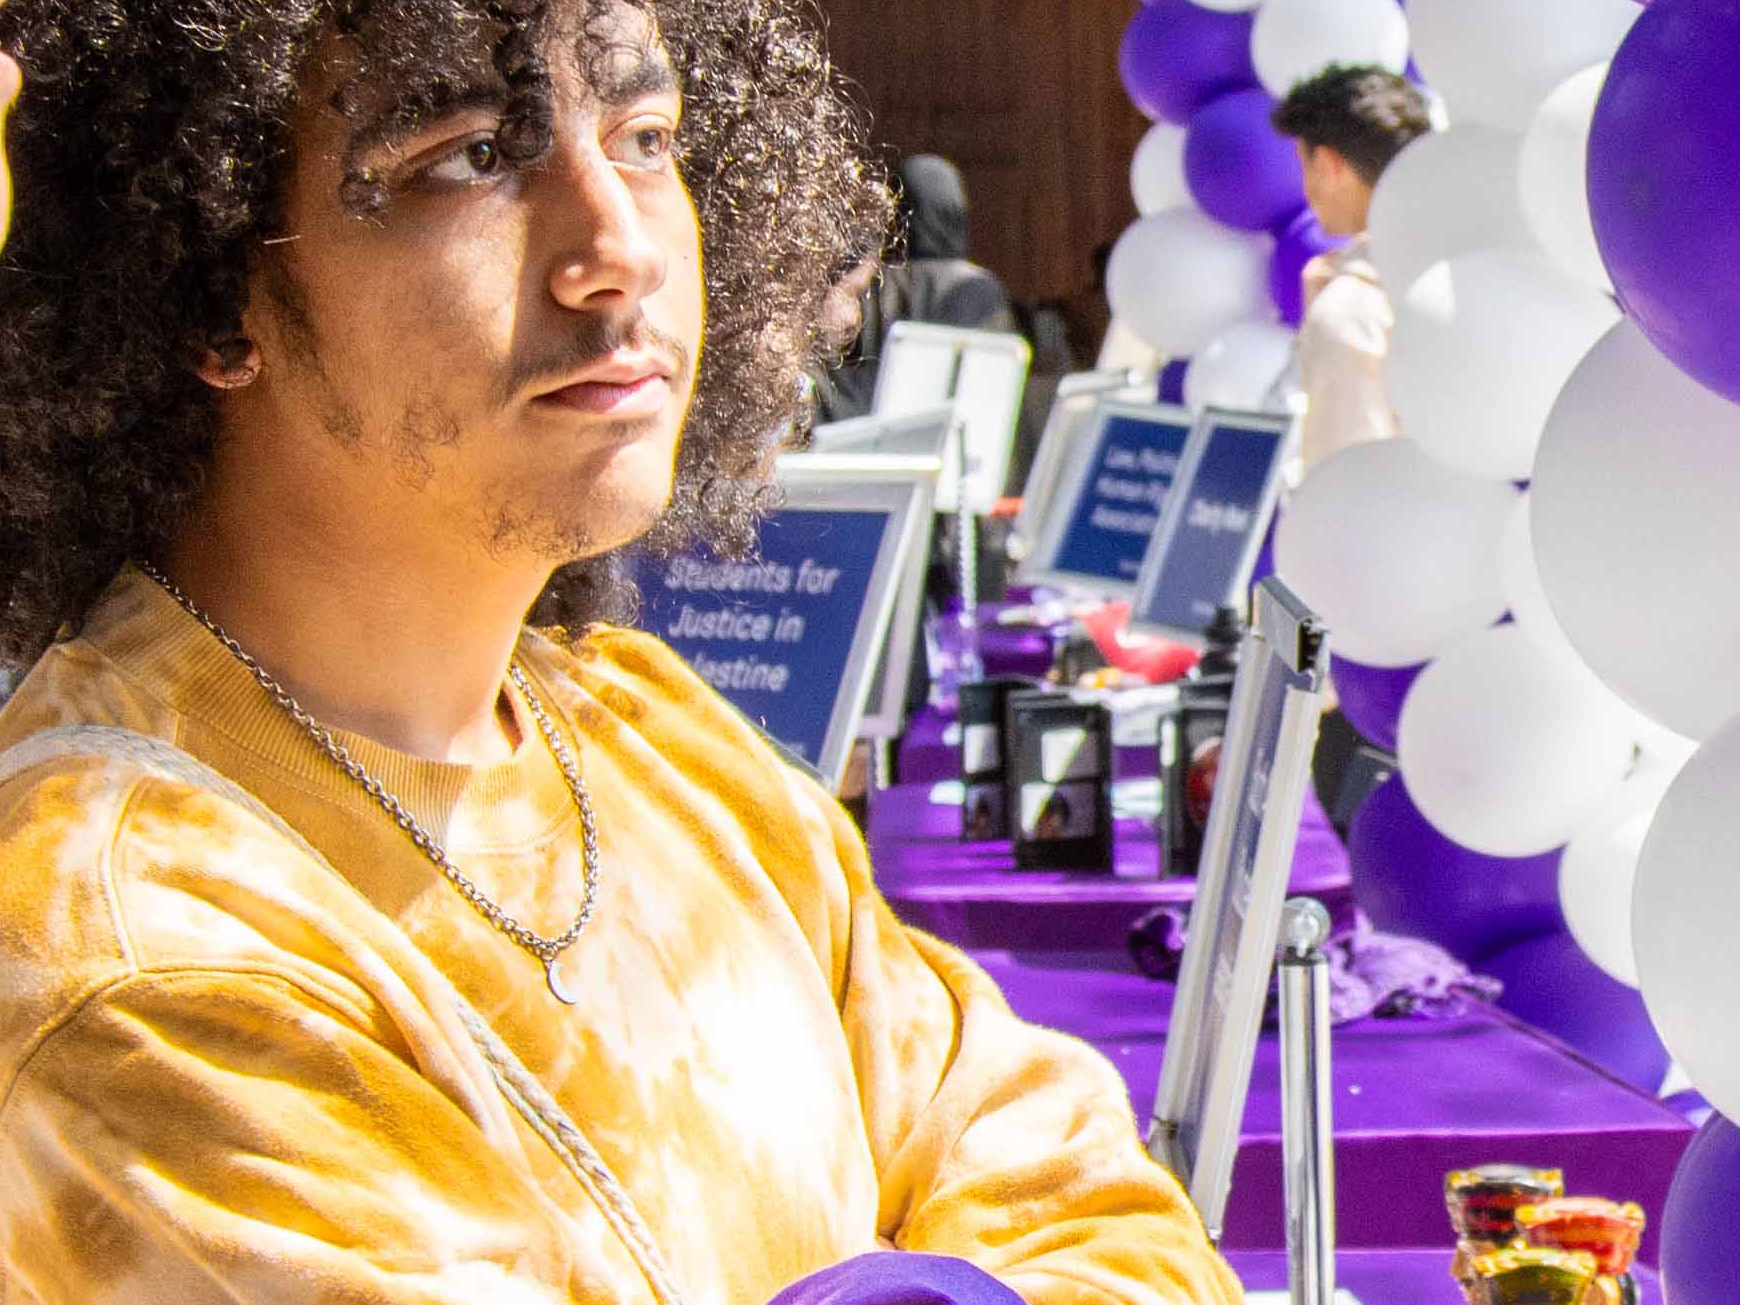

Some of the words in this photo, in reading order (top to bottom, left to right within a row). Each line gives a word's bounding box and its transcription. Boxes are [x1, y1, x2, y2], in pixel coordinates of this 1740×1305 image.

[664, 557, 792, 593] Students
[796, 559, 839, 594] for
[668, 603, 771, 641] Justice
[774, 606, 805, 642] in
